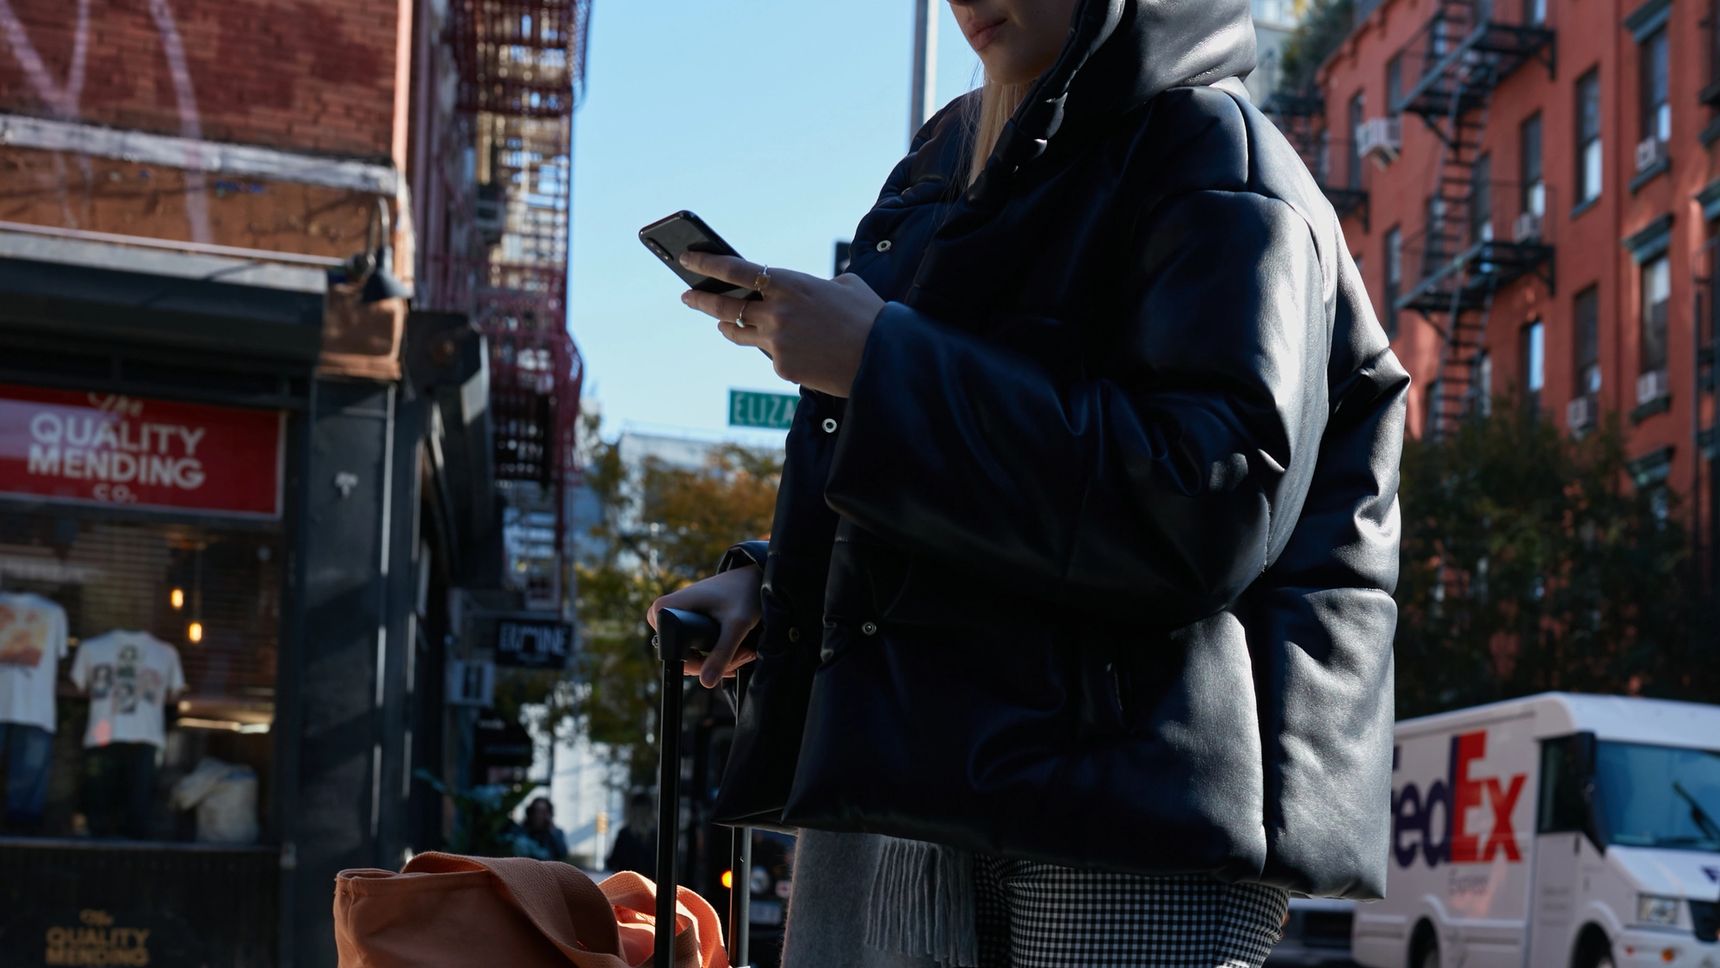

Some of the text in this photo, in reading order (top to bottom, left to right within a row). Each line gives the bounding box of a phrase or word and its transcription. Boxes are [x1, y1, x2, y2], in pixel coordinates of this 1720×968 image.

[30, 412, 206, 456] QUALITY
[28, 443, 205, 490] MENDING
[1391, 730, 1528, 869] edEx
[46, 926, 150, 949] QUALITY
